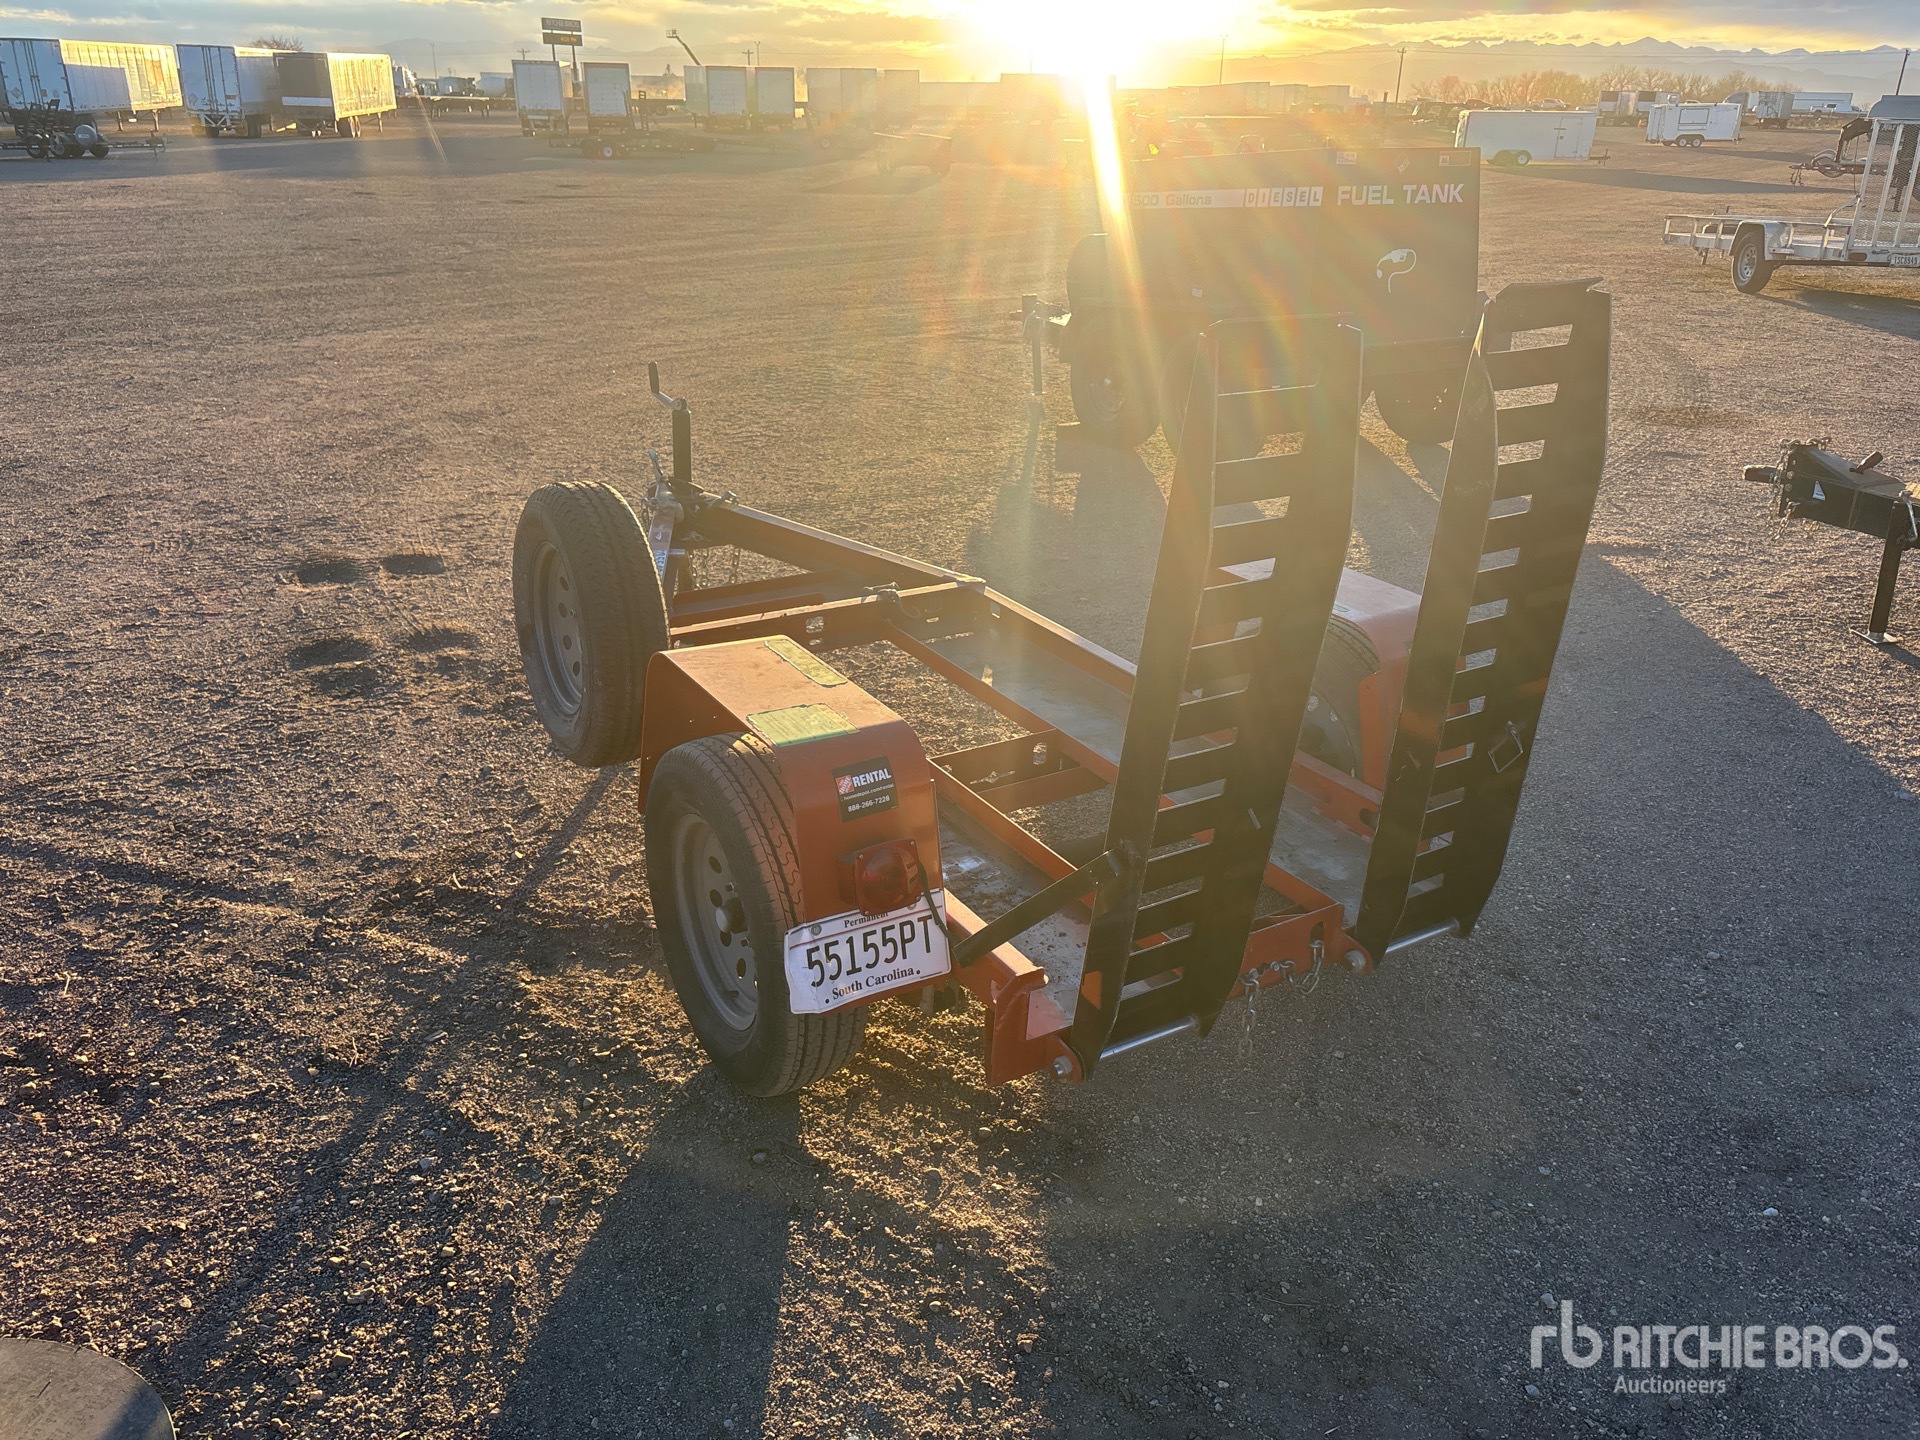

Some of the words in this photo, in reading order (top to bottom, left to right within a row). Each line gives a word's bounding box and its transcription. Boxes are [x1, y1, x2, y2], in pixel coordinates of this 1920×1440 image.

[1166, 193, 1213, 207] Gallons
[1246, 189, 1321, 205] DIESEL
[1337, 185, 1395, 206] FUEL
[1403, 183, 1465, 205] TANK
[852, 768, 892, 788] RENTAL
[806, 914, 933, 987] 55155PT
[831, 978, 863, 1000] South
[865, 967, 915, 988] Carolina
